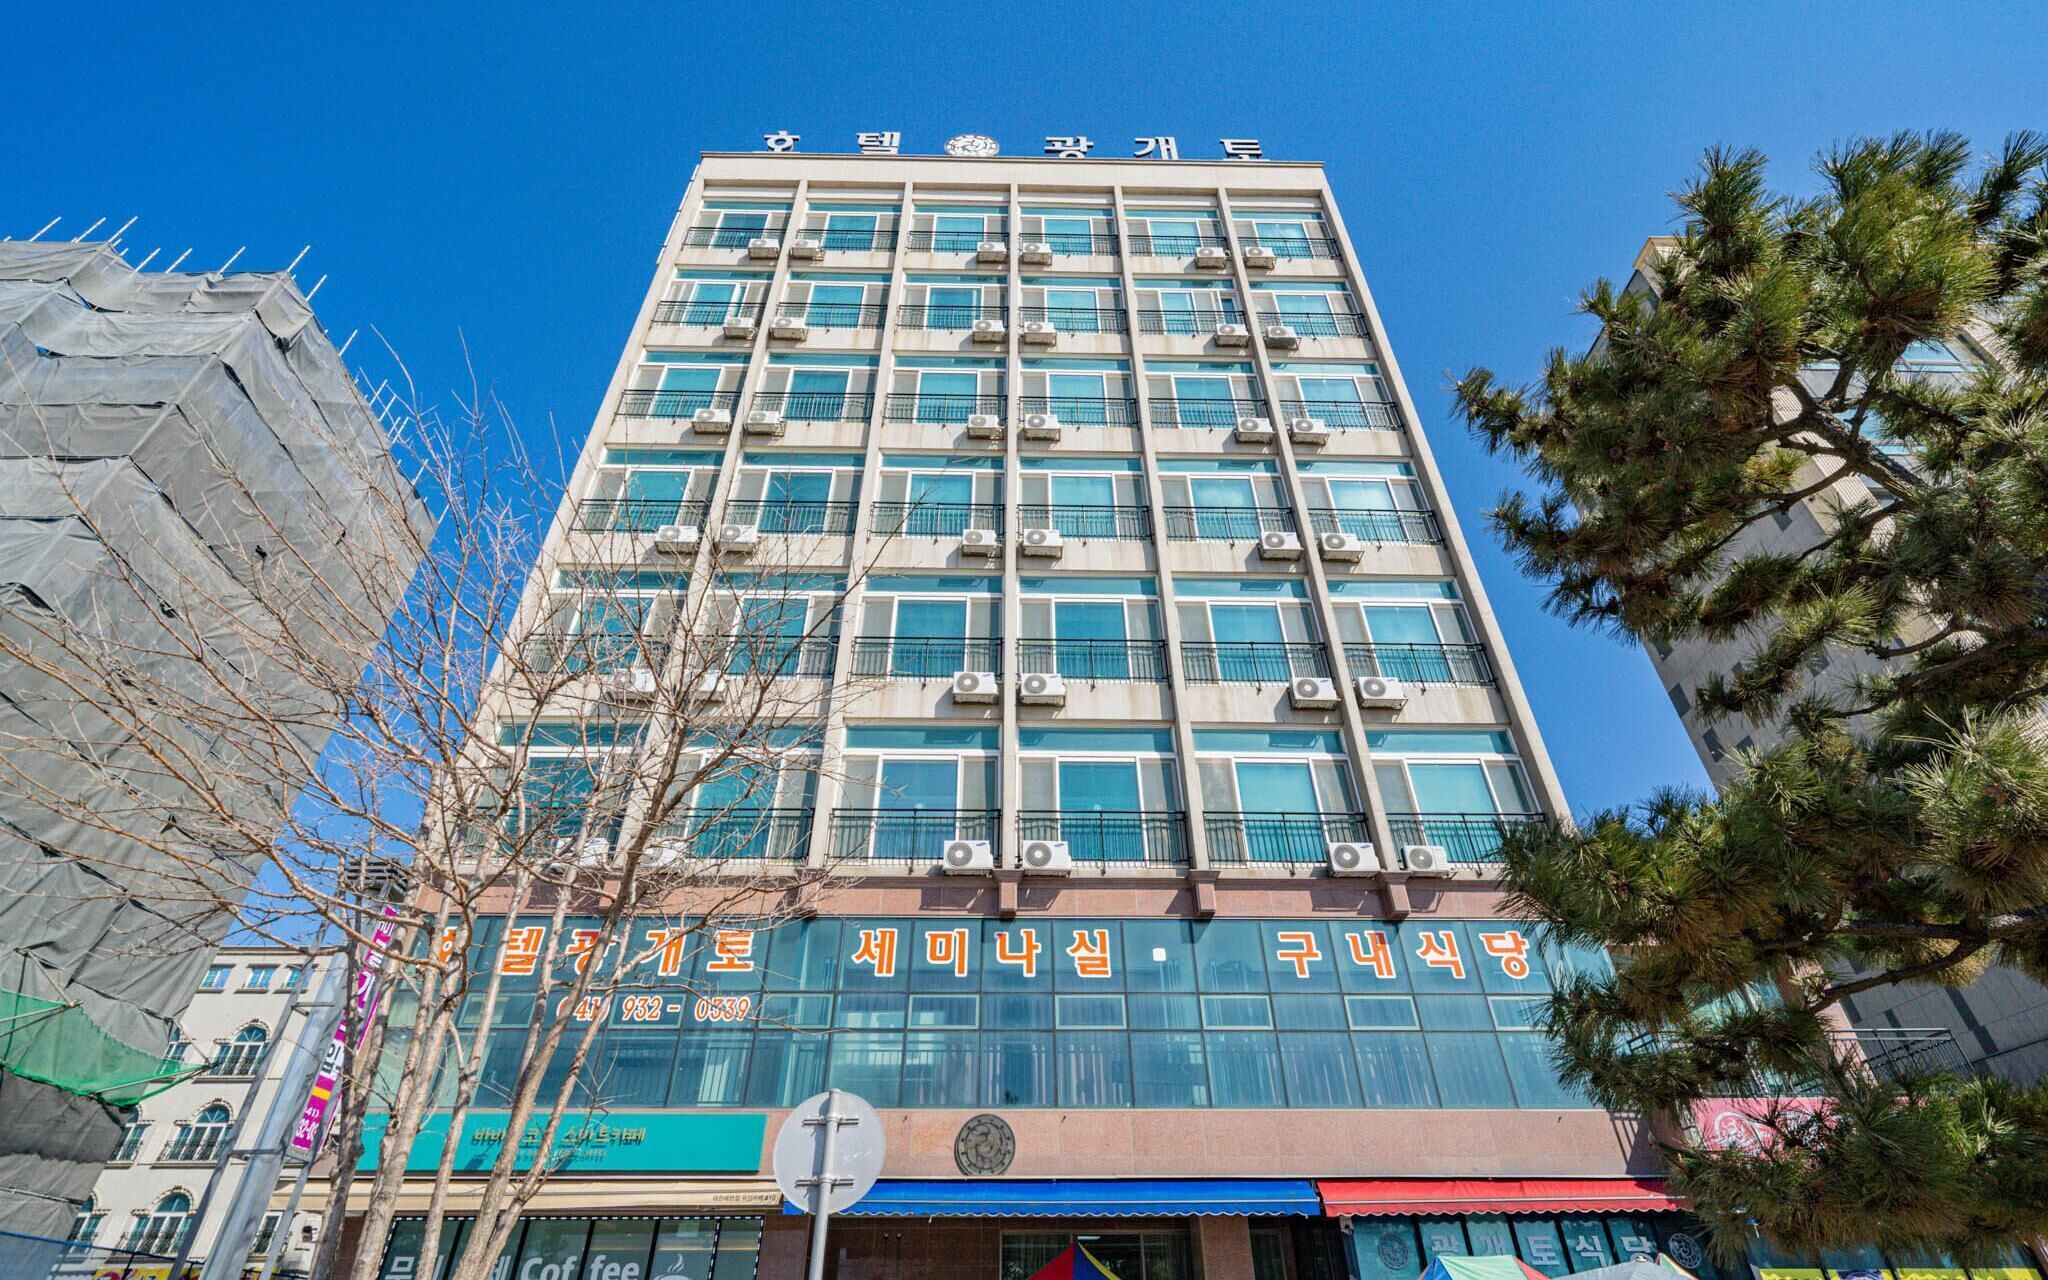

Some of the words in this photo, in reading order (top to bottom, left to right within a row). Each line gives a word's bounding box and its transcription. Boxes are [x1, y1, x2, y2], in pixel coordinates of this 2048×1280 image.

[758, 130, 901, 154] 호텔
[1044, 136, 1270, 161] 광개토
[852, 928, 1112, 977] 세미나실
[1277, 930, 1530, 979] 구내식당
